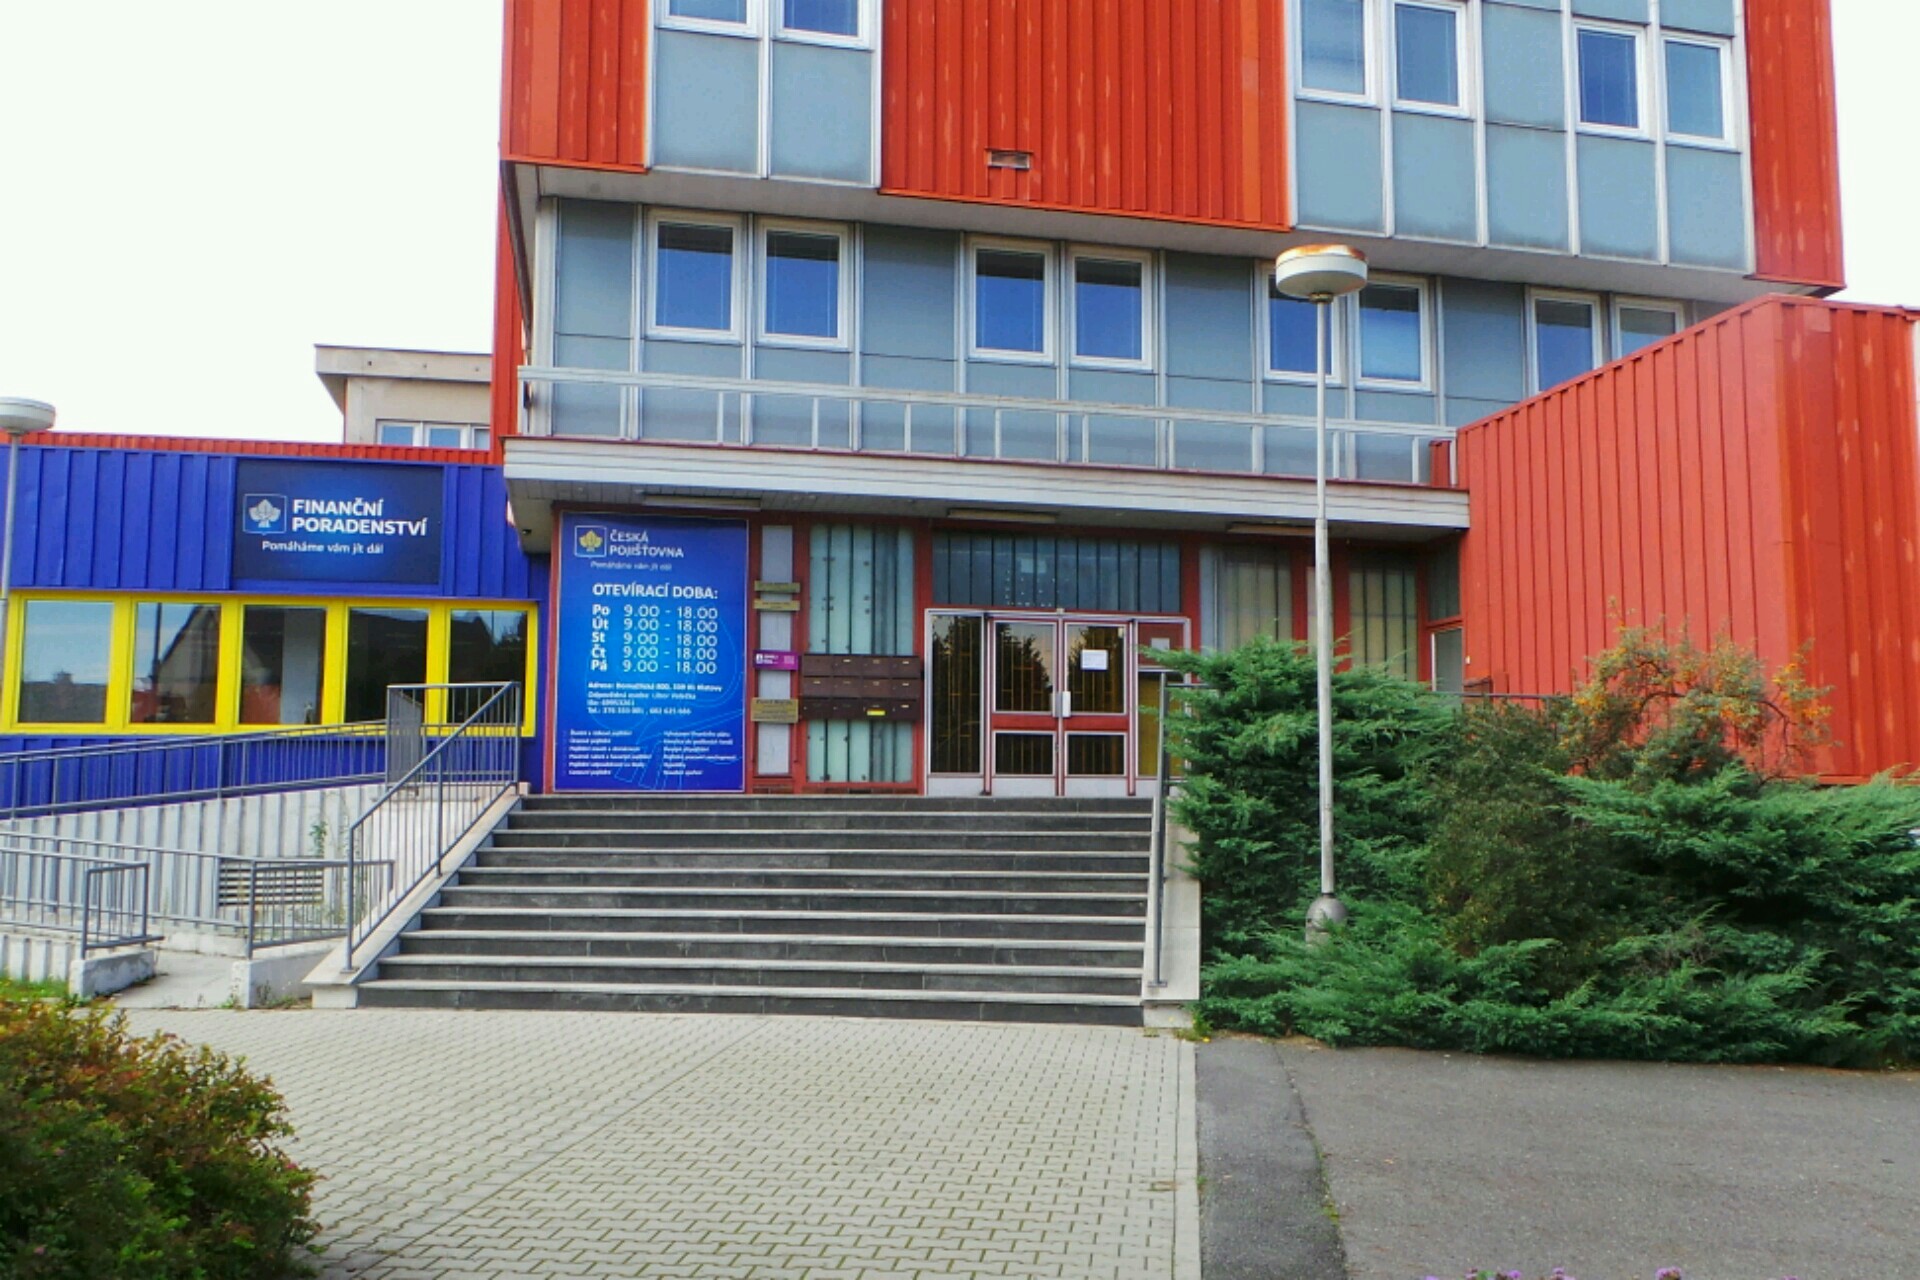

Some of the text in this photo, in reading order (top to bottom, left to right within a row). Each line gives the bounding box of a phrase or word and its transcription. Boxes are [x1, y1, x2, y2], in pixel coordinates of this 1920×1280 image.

[292, 497, 384, 517] FINANČNÍ
[291, 516, 429, 537] PORADENSTVÍ
[609, 528, 649, 543] ČESKÁ
[262, 541, 325, 553] Pomáháme
[327, 542, 350, 554] vám
[352, 543, 364, 555] jít
[609, 543, 685, 559] POJIŠŤOVNA
[592, 580, 718, 600] OTEVÍRACÍ DOBA:
[592, 604, 611, 617] Po
[623, 604, 660, 617] 9.00
[677, 606, 719, 620] 18.00
[592, 615, 609, 631] Út
[623, 618, 660, 631] 9.00
[677, 620, 719, 633] 18.00
[591, 631, 606, 643] St
[623, 632, 659, 645] 9.00
[676, 634, 718, 647] 18.00
[591, 644, 607, 659] Čt
[623, 646, 659, 659] 9.00
[676, 648, 718, 661] 18.00
[590, 659, 608, 672] Pá
[622, 659, 659, 673] 9.00
[676, 661, 717, 674] 18.00
